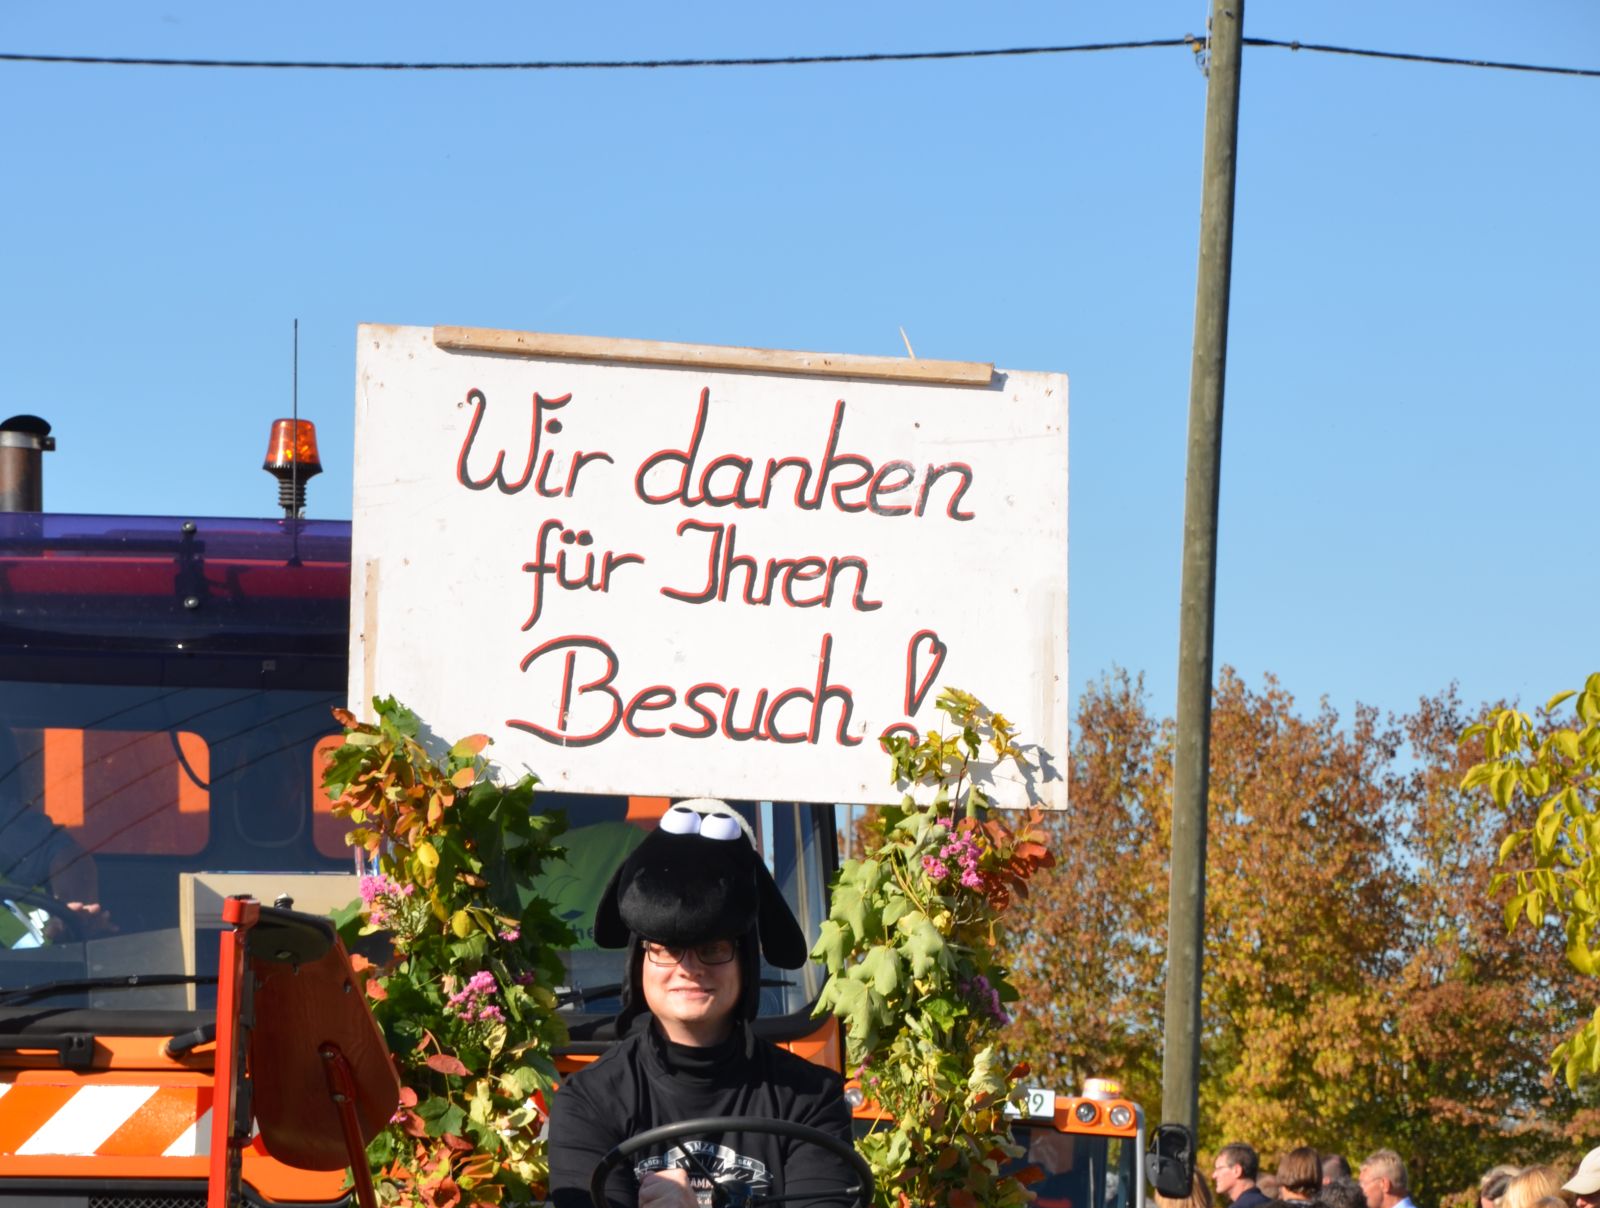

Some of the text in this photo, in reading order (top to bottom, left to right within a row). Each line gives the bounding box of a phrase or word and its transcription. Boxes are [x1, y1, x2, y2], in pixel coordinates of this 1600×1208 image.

[456, 386, 975, 521] Wir danken
[521, 519, 883, 632] für Ihren
